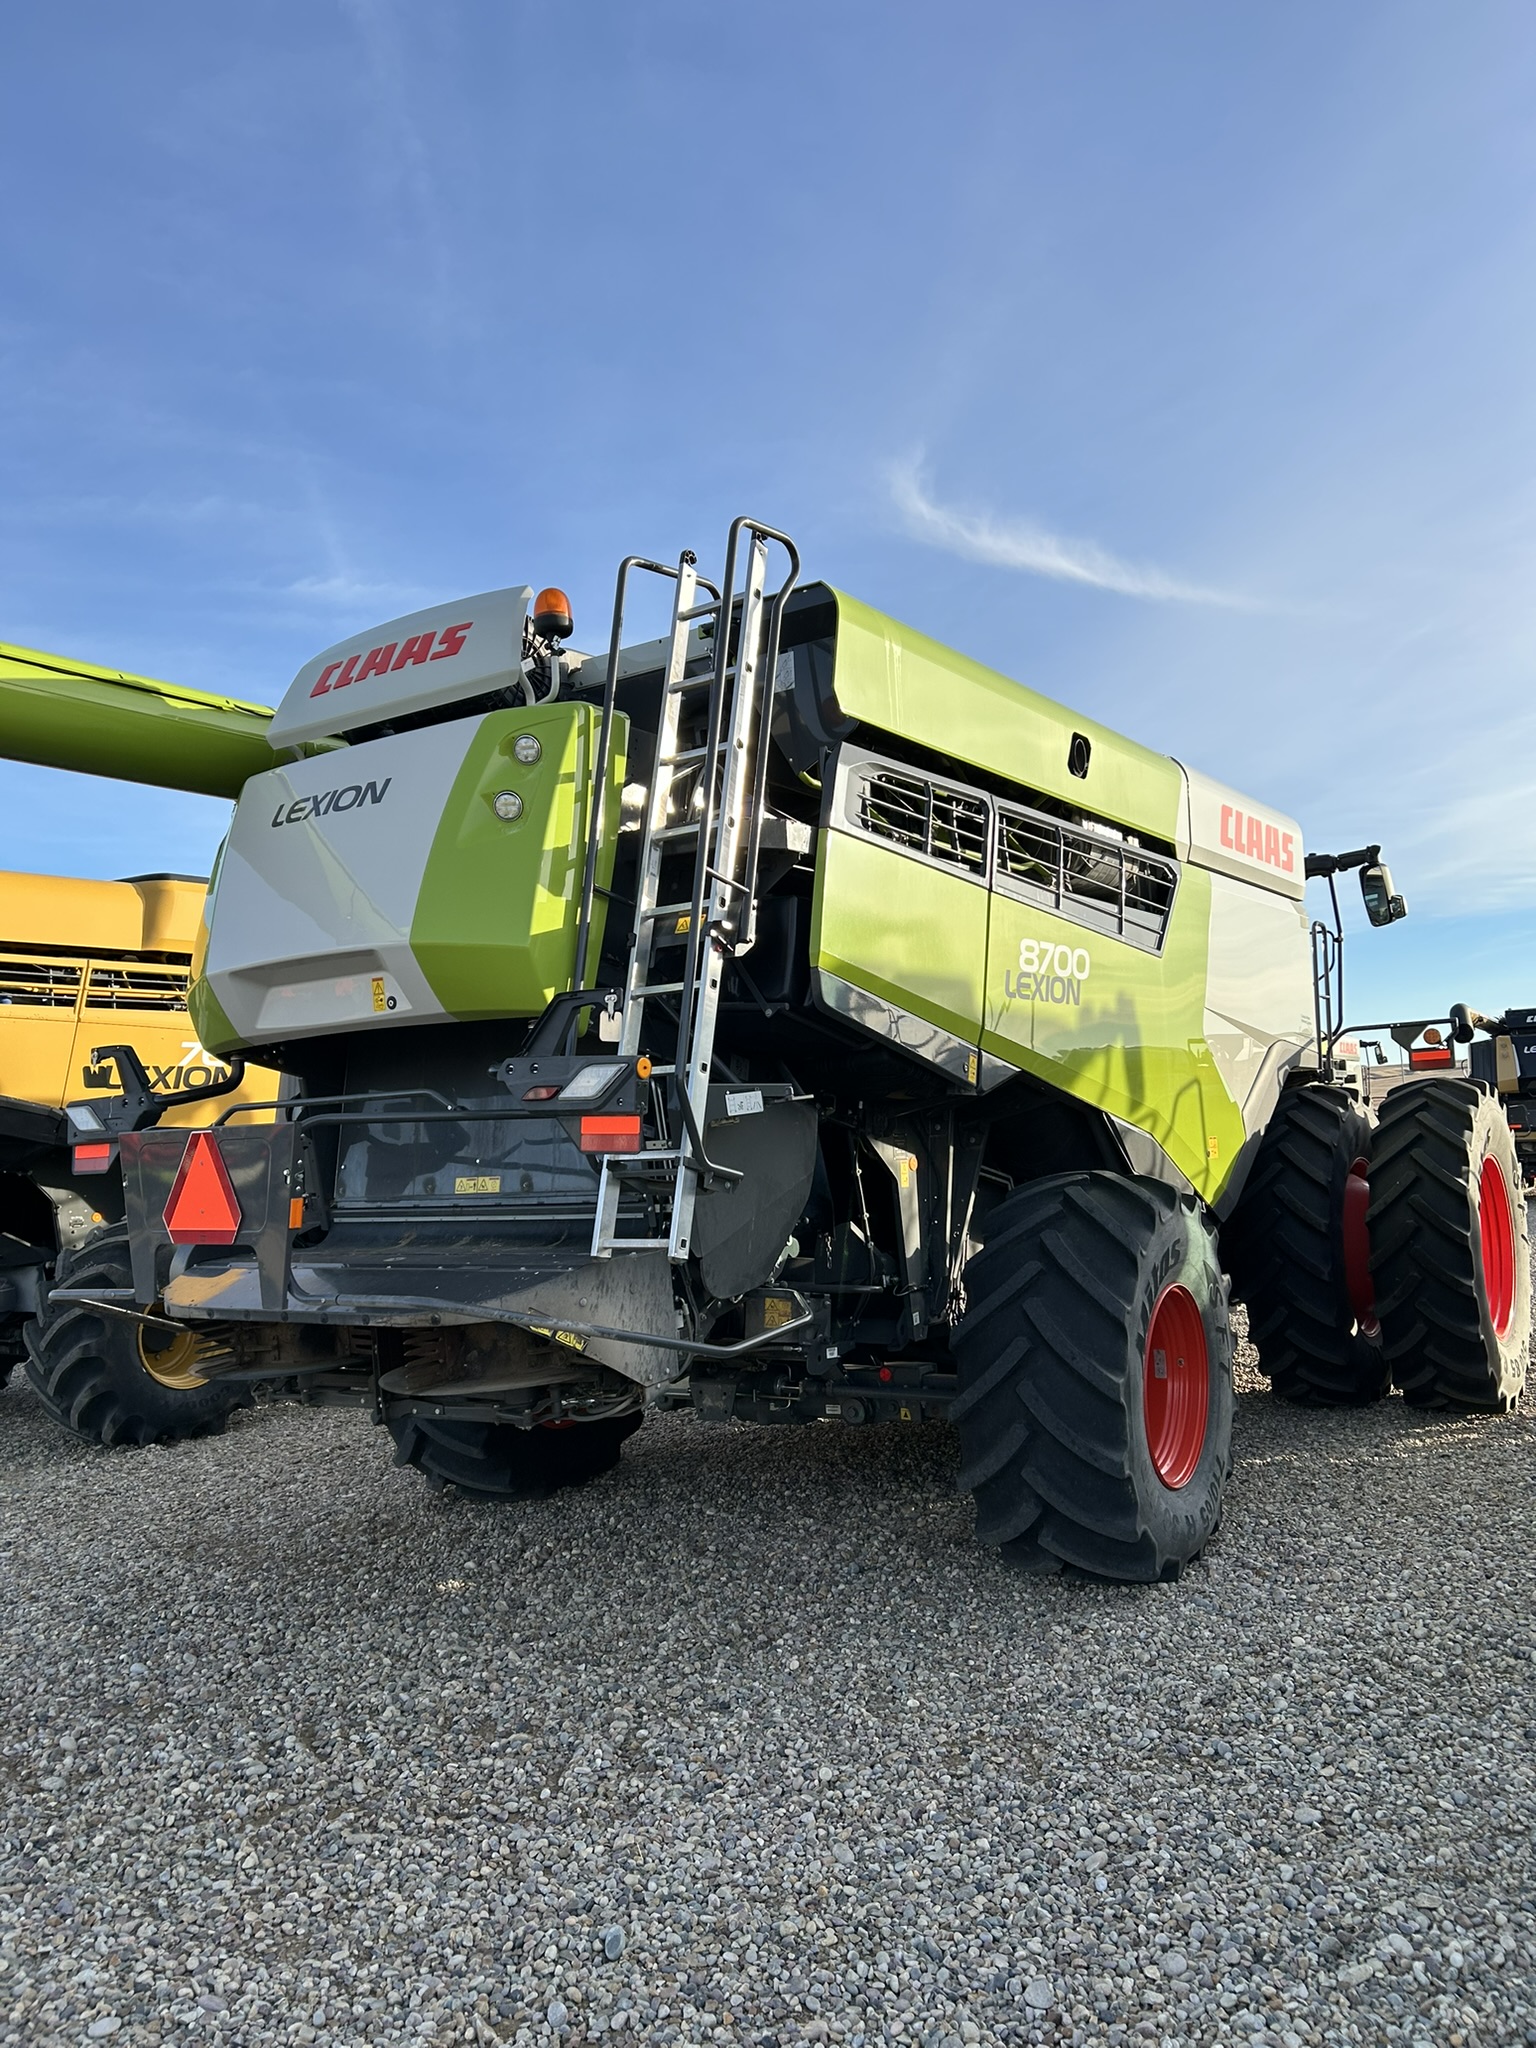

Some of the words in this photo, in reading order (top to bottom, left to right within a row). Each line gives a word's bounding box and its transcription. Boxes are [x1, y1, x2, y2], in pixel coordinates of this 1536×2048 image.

[309, 621, 474, 699] CLAAS
[271, 777, 393, 828] LEXION
[1220, 803, 1294, 873] CLAAS
[1019, 938, 1091, 981] 8700
[1005, 969, 1081, 1006] LEXION
[1339, 1041, 1358, 1055] CLAAS
